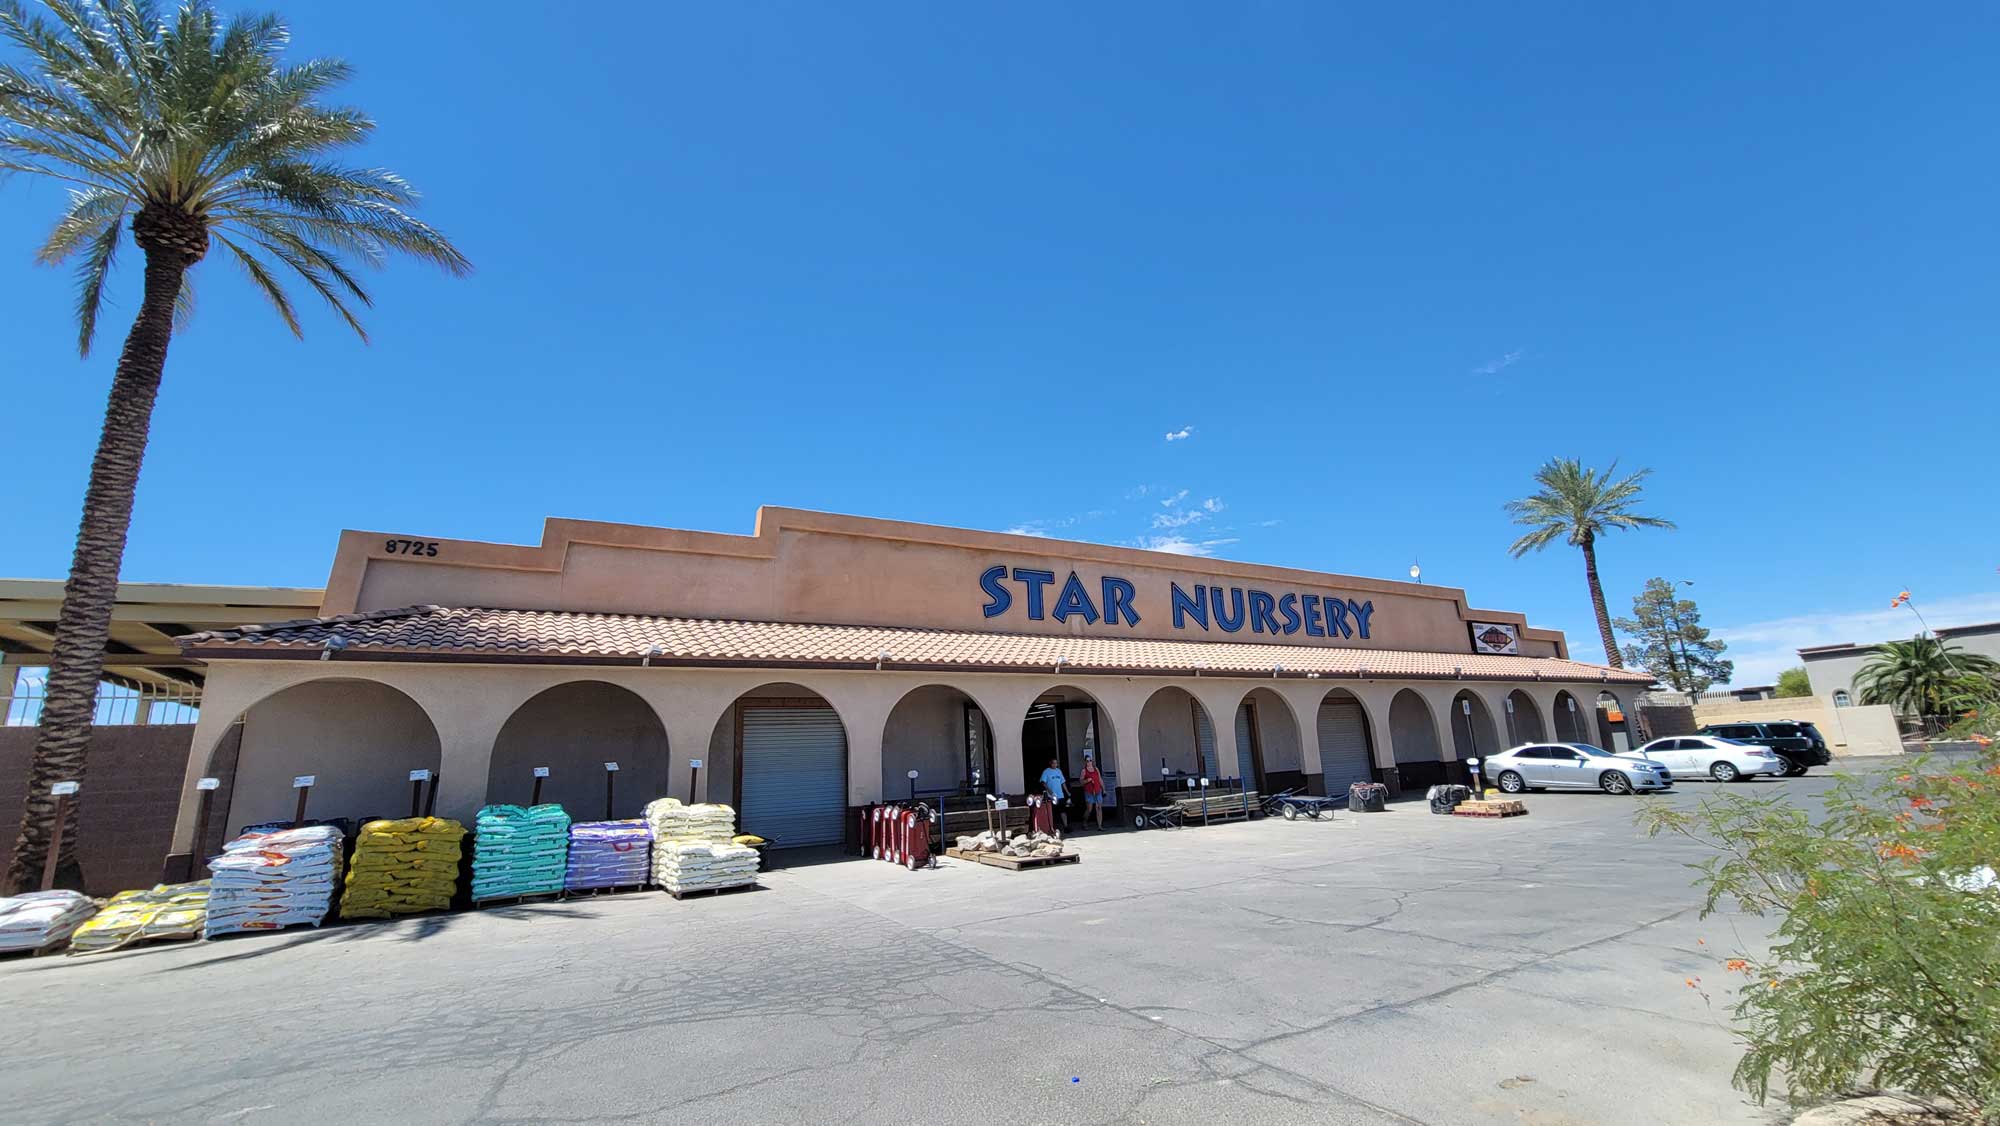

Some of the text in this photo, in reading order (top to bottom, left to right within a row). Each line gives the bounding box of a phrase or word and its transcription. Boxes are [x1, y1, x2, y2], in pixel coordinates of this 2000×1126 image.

[385, 539, 439, 557] 8725
[979, 565, 1375, 640] STAR NURSERY
